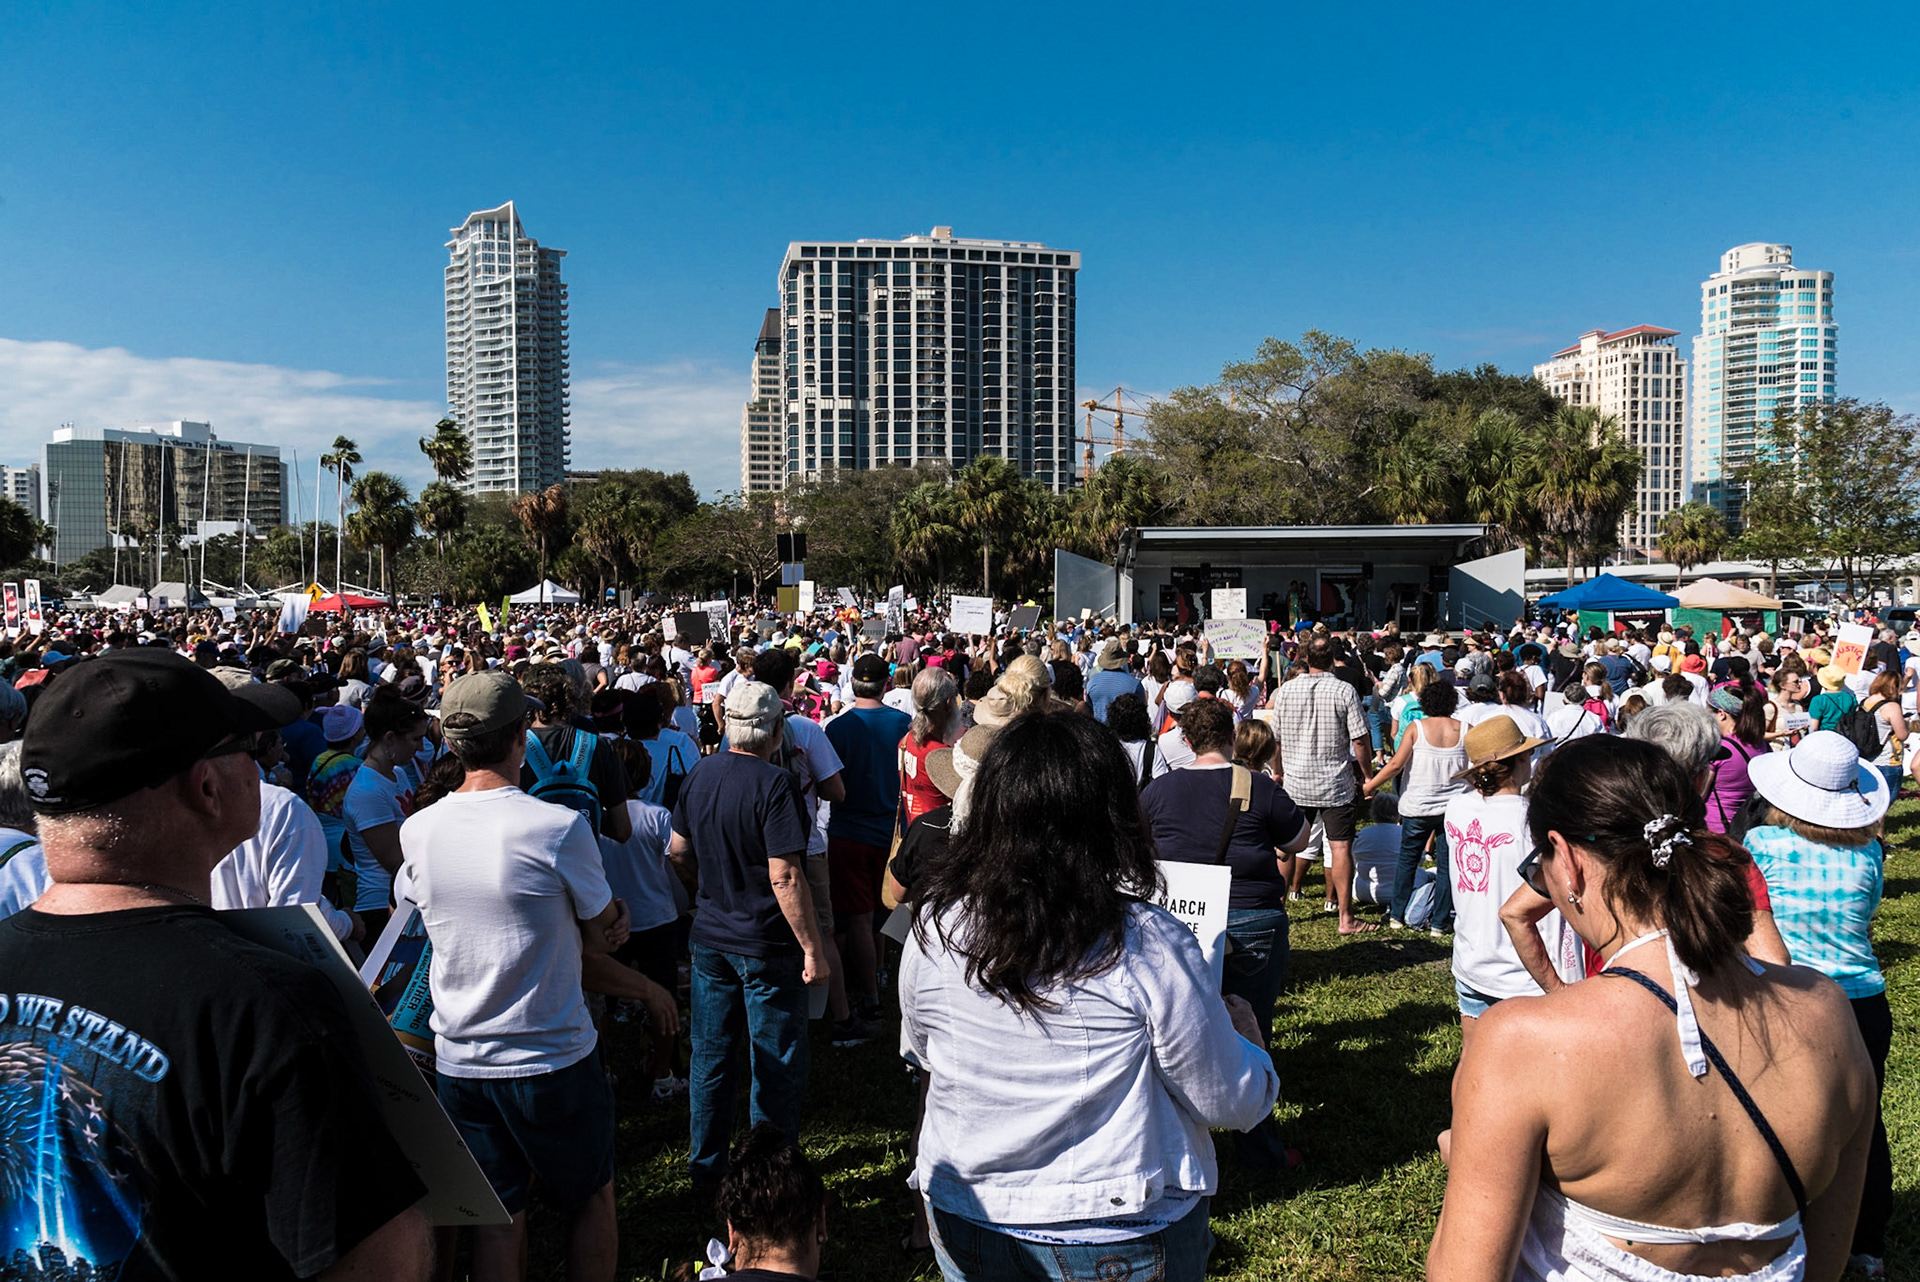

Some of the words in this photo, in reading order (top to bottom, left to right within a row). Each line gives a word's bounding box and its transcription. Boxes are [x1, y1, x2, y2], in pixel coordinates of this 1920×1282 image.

[1836, 645, 1863, 661] JUSTICE
[1158, 898, 1206, 916] MARCH
[15, 992, 65, 1032] WE
[57, 1004, 173, 1084] STAND
